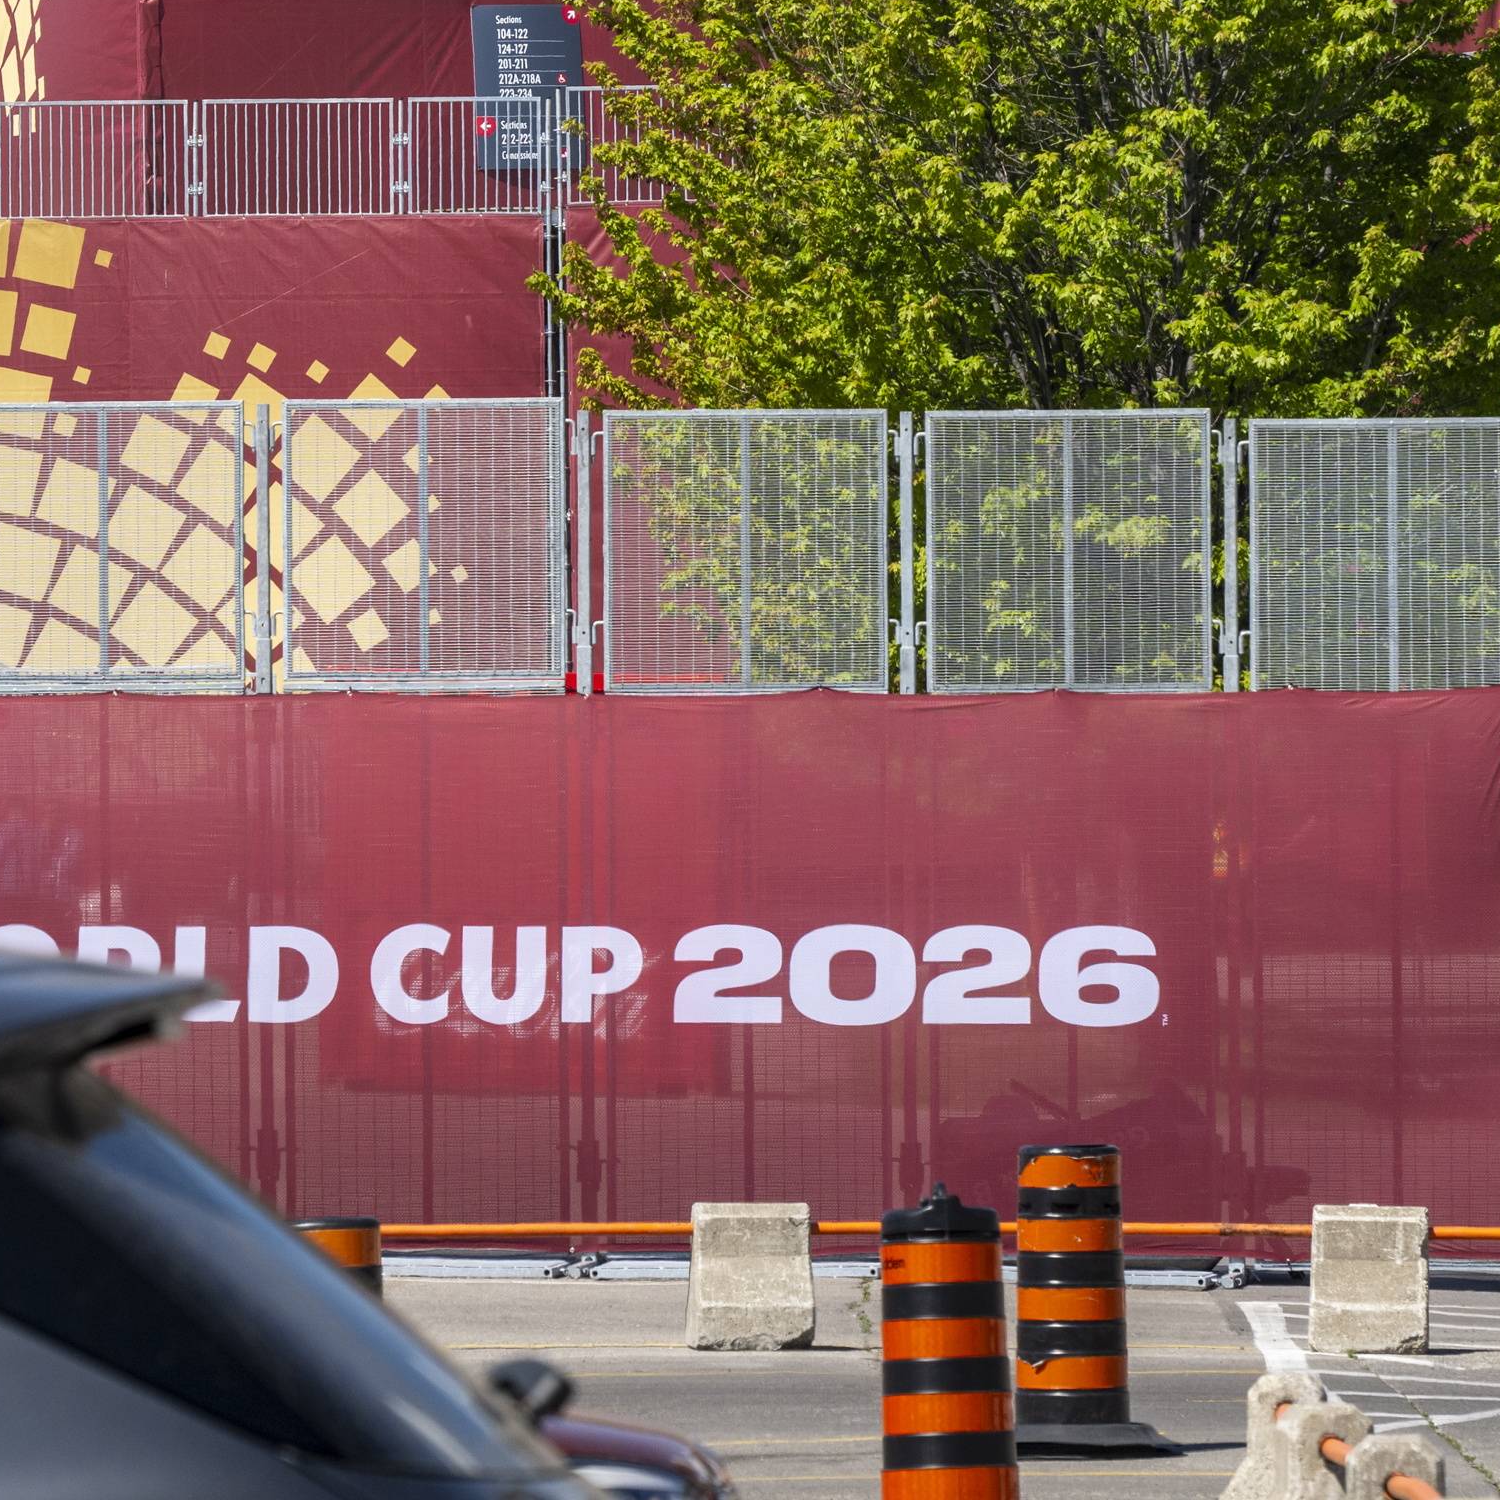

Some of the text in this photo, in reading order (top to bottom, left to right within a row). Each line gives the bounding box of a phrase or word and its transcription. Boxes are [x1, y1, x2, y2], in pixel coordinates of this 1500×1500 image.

[495, 14, 522, 25] Sections
[496, 28, 529, 40] 104-122
[497, 43, 528, 54] 124-127
[498, 58, 528, 70] 201-211
[498, 73, 541, 85] 212A-218A
[370, 923, 644, 1026] CUP
[673, 924, 1161, 1027] 2026
